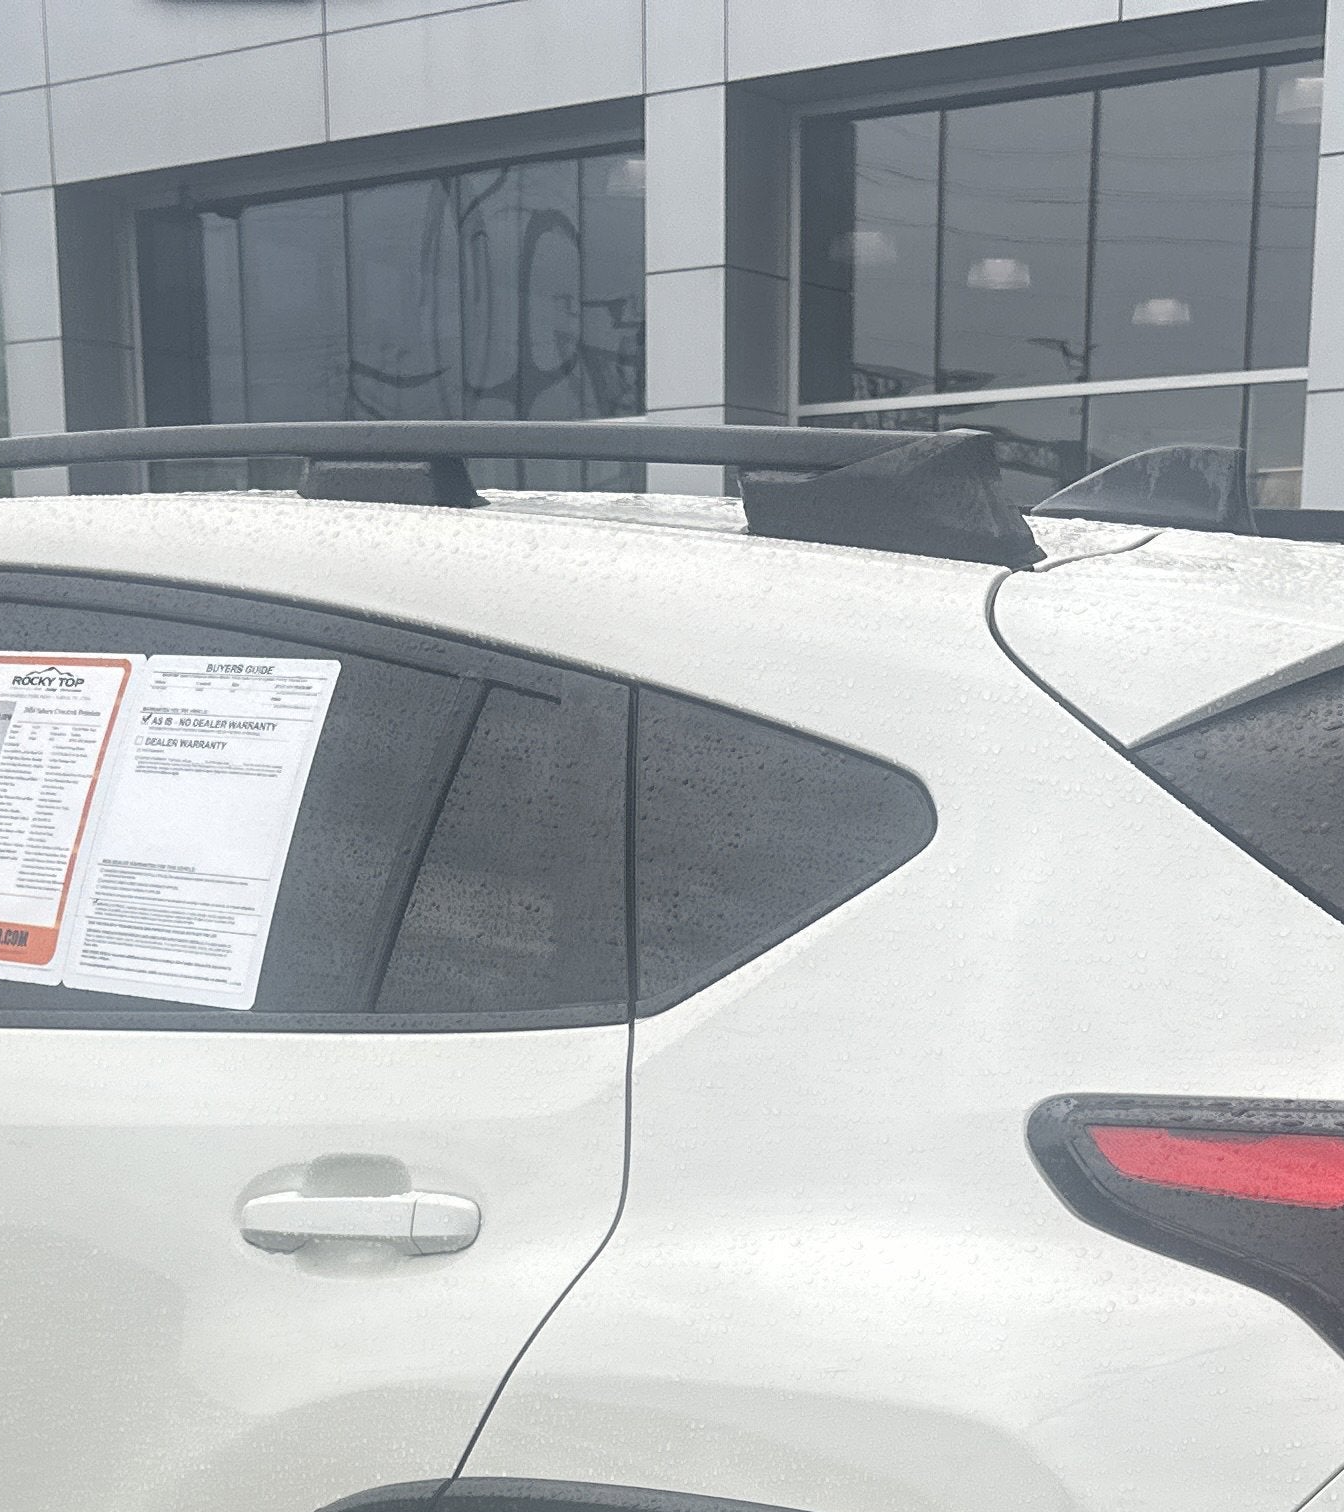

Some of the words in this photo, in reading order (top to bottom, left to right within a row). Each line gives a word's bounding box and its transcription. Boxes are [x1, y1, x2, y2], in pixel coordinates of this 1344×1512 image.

[206, 664, 243, 674] BUYERS
[245, 665, 275, 675] GUIDE
[12, 676, 56, 687] ROCKY
[58, 677, 85, 688] TOP
[151, 716, 163, 726] AS
[179, 718, 192, 728] NO
[192, 719, 227, 730] DEALER
[228, 721, 278, 732] WARRANTY
[145, 737, 178, 747] DEALER
[179, 738, 227, 751] WARRANTY
